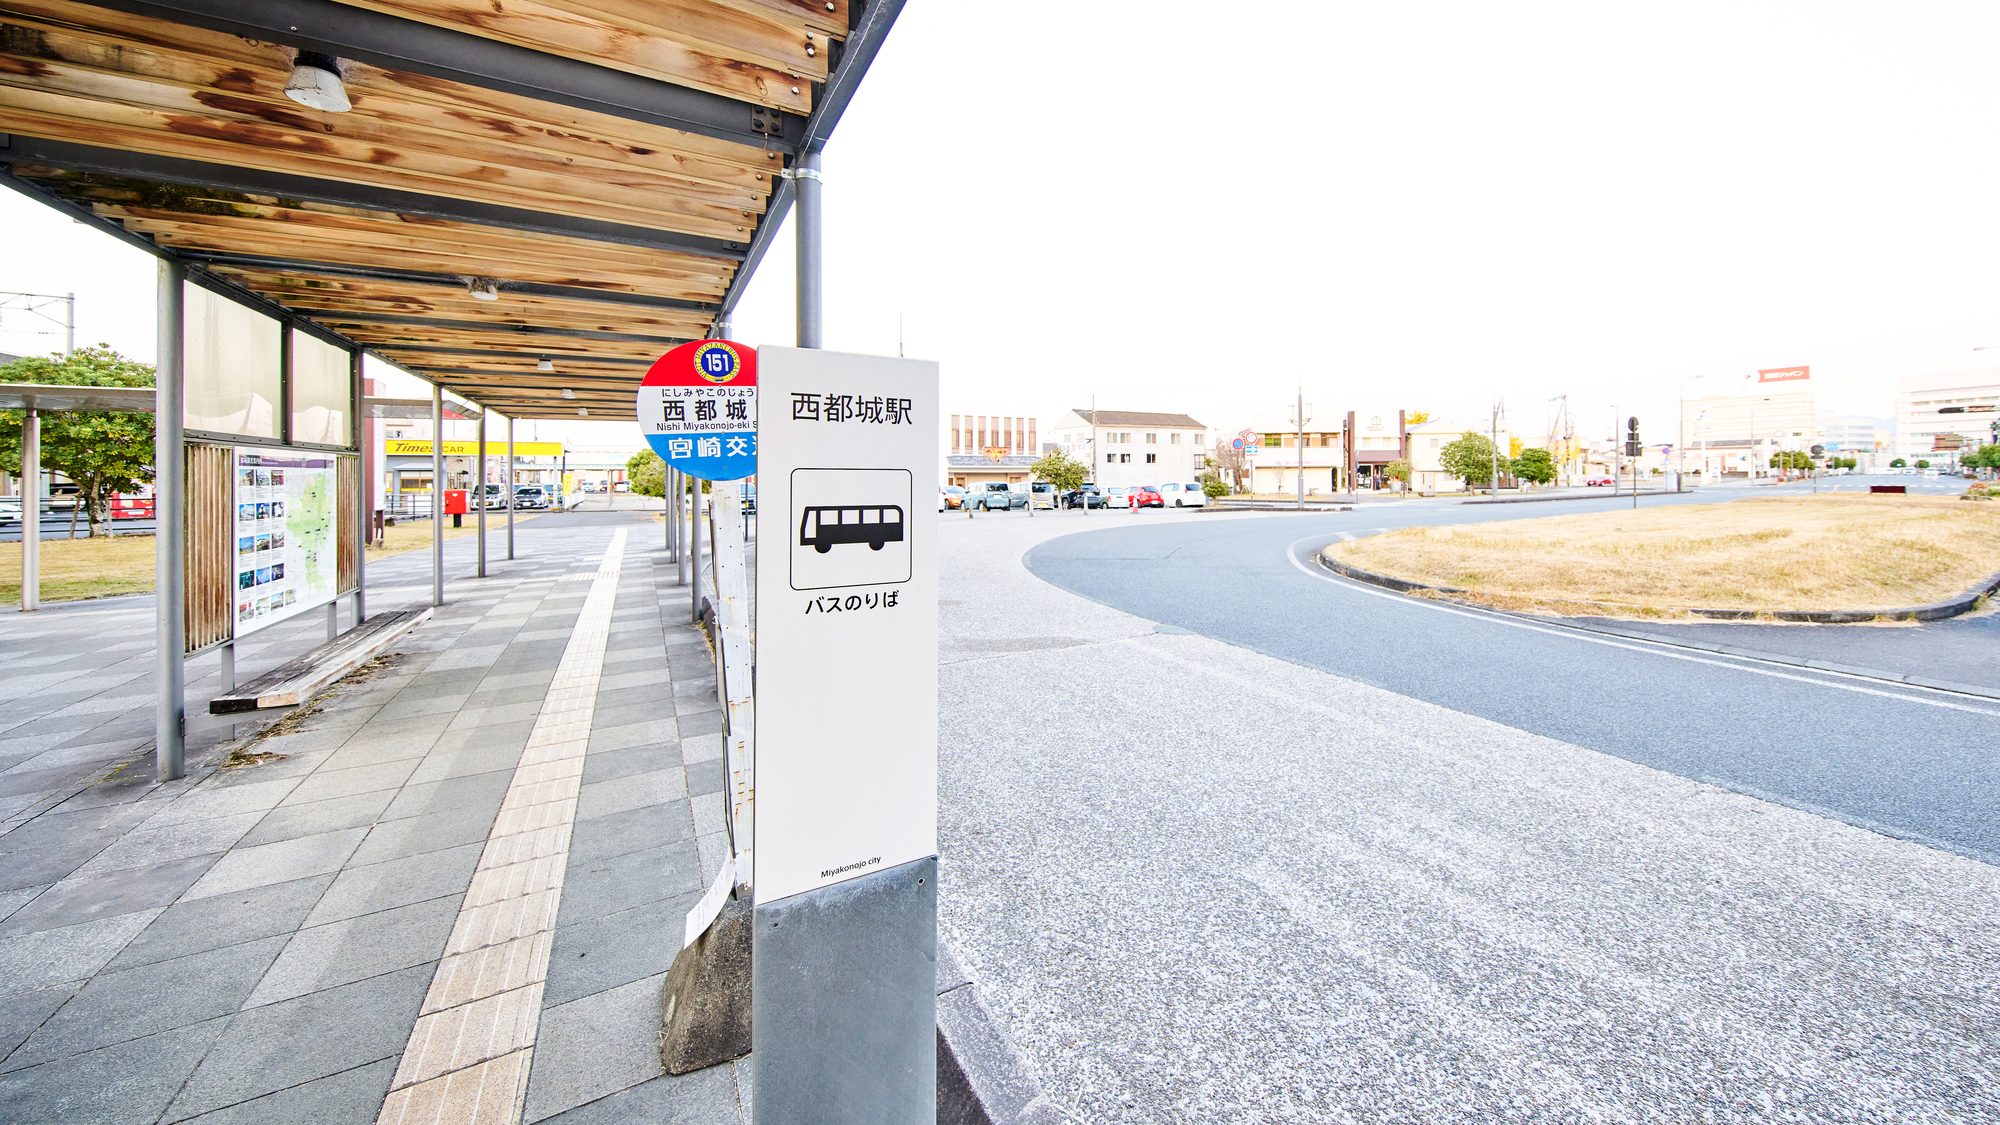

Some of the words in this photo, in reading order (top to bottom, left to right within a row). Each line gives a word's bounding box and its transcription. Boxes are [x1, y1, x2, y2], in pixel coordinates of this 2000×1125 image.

[705, 353, 729, 372] 151
[662, 388, 754, 397] にしみやこのじょう
[662, 399, 748, 422] 西都城
[791, 392, 912, 425] 西都城駅
[656, 422, 680, 431] Nishi
[684, 421, 750, 431] Miyakonojo-eki
[395, 443, 434, 453] Times
[805, 590, 900, 614] バスのりば
[820, 860, 867, 878] Miyakonojo
[867, 856, 881, 864] city
